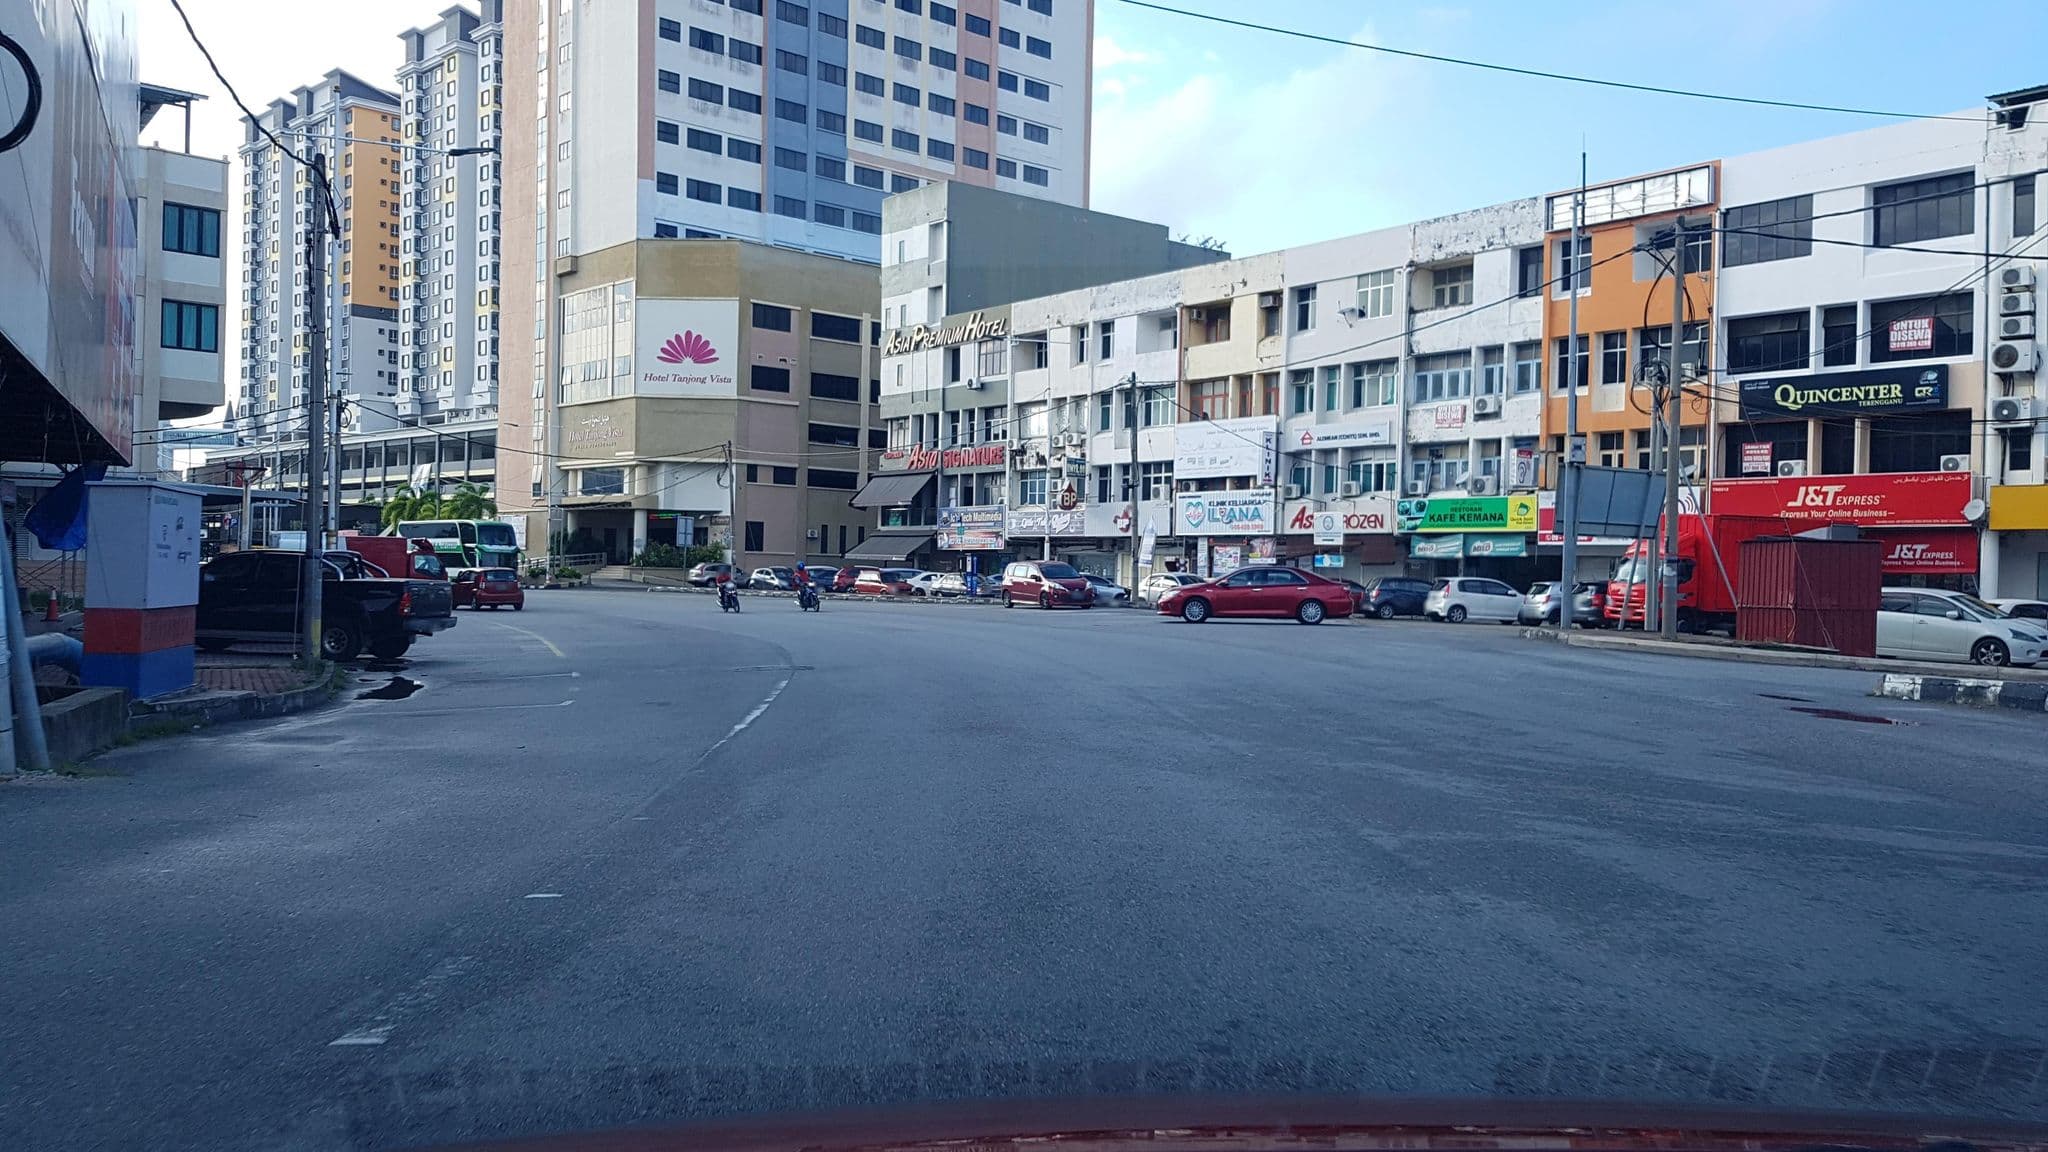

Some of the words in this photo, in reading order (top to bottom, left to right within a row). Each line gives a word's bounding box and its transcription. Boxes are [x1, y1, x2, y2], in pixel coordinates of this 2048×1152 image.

[1890, 329, 1931, 341] DISEWA
[643, 372, 669, 382] Hotel
[672, 373, 707, 385] Tanjong
[710, 374, 732, 384] Vista
[1775, 384, 1903, 410] QUINCENTER
[1858, 399, 1904, 407] TERENGGANU
[943, 446, 1005, 469] SIGNATURE
[1063, 494, 1077, 506] BP
[1787, 485, 1846, 507] J&T
[1836, 495, 1880, 506] EXPRESS
[1429, 513, 1456, 523] KAFE
[1459, 512, 1504, 522] KEMANA
[1781, 510, 1808, 519] Express
[1811, 510, 1826, 518] Your
[1828, 509, 1851, 517] Online
[1853, 508, 1887, 517] Business
[1887, 544, 1930, 559] J&T
